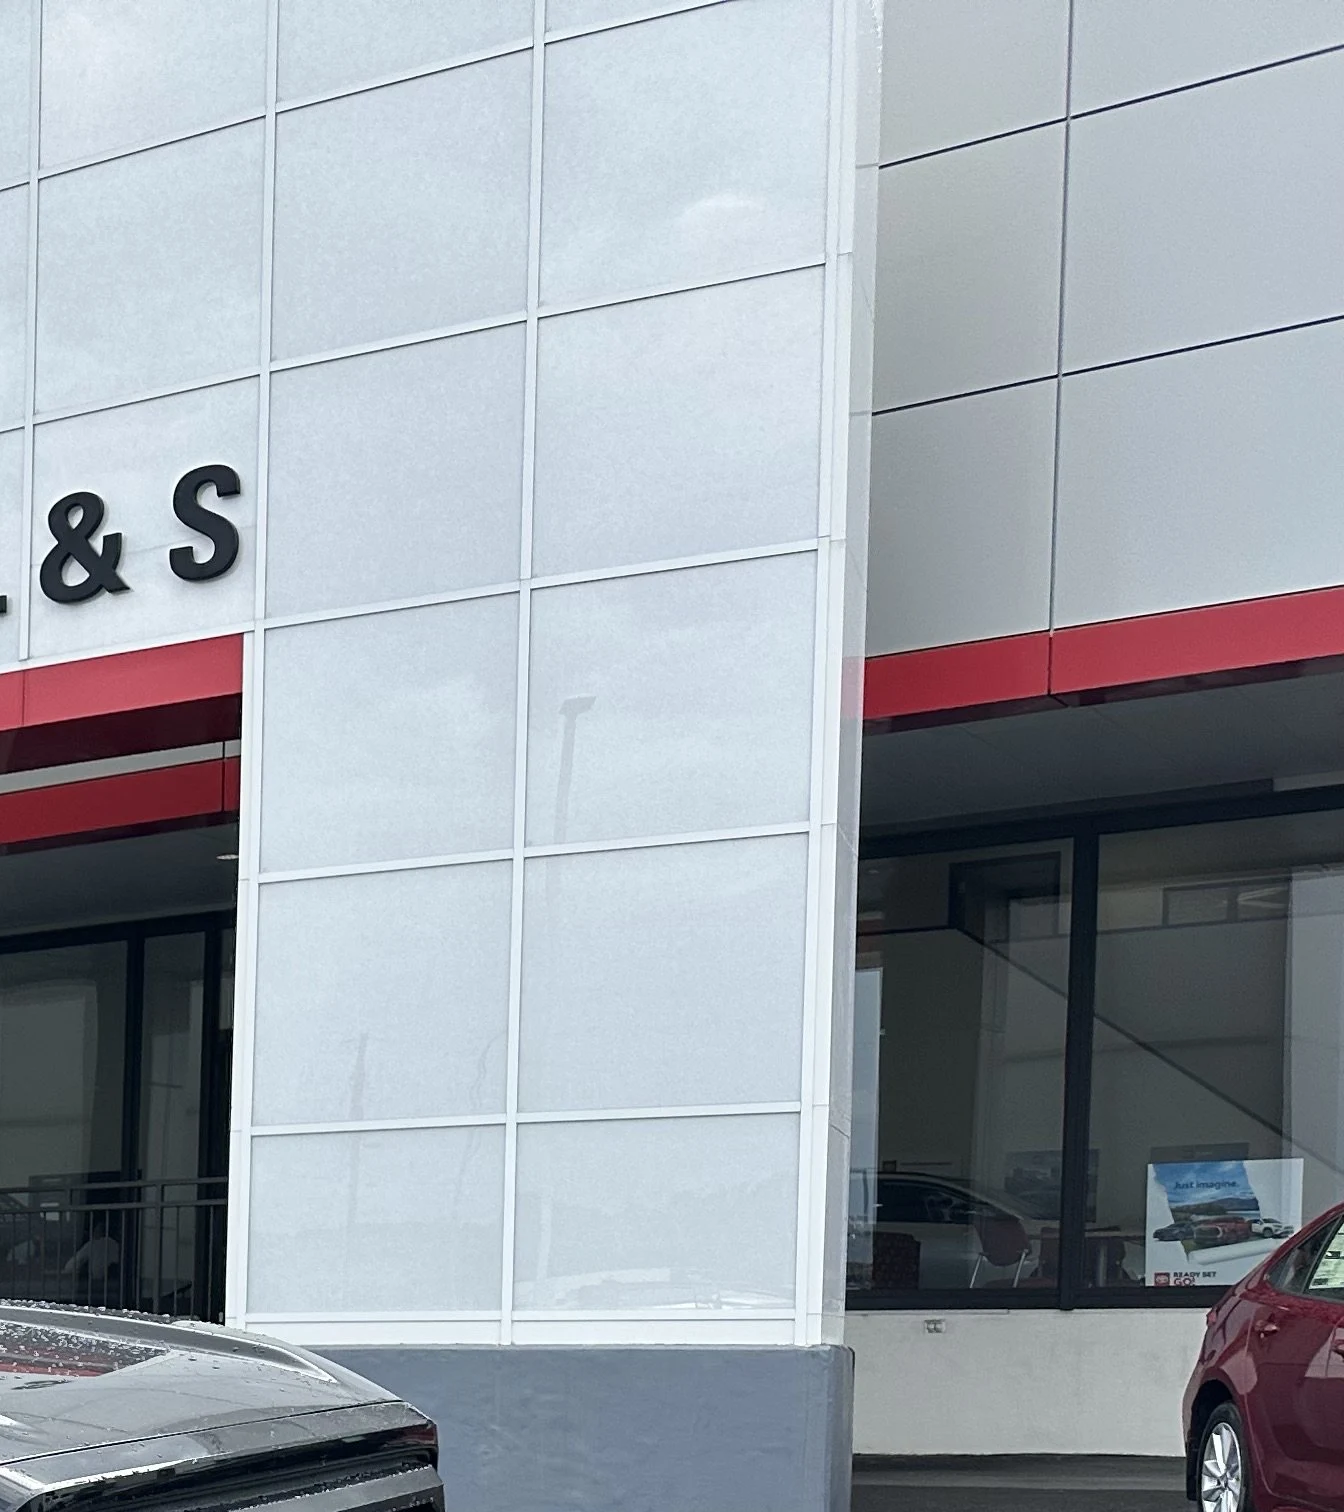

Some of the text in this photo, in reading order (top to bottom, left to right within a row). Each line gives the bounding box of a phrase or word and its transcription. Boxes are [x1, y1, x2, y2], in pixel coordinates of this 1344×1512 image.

[39, 491, 131, 604] &
[169, 464, 241, 583] S
[1174, 1181, 1194, 1190] Just
